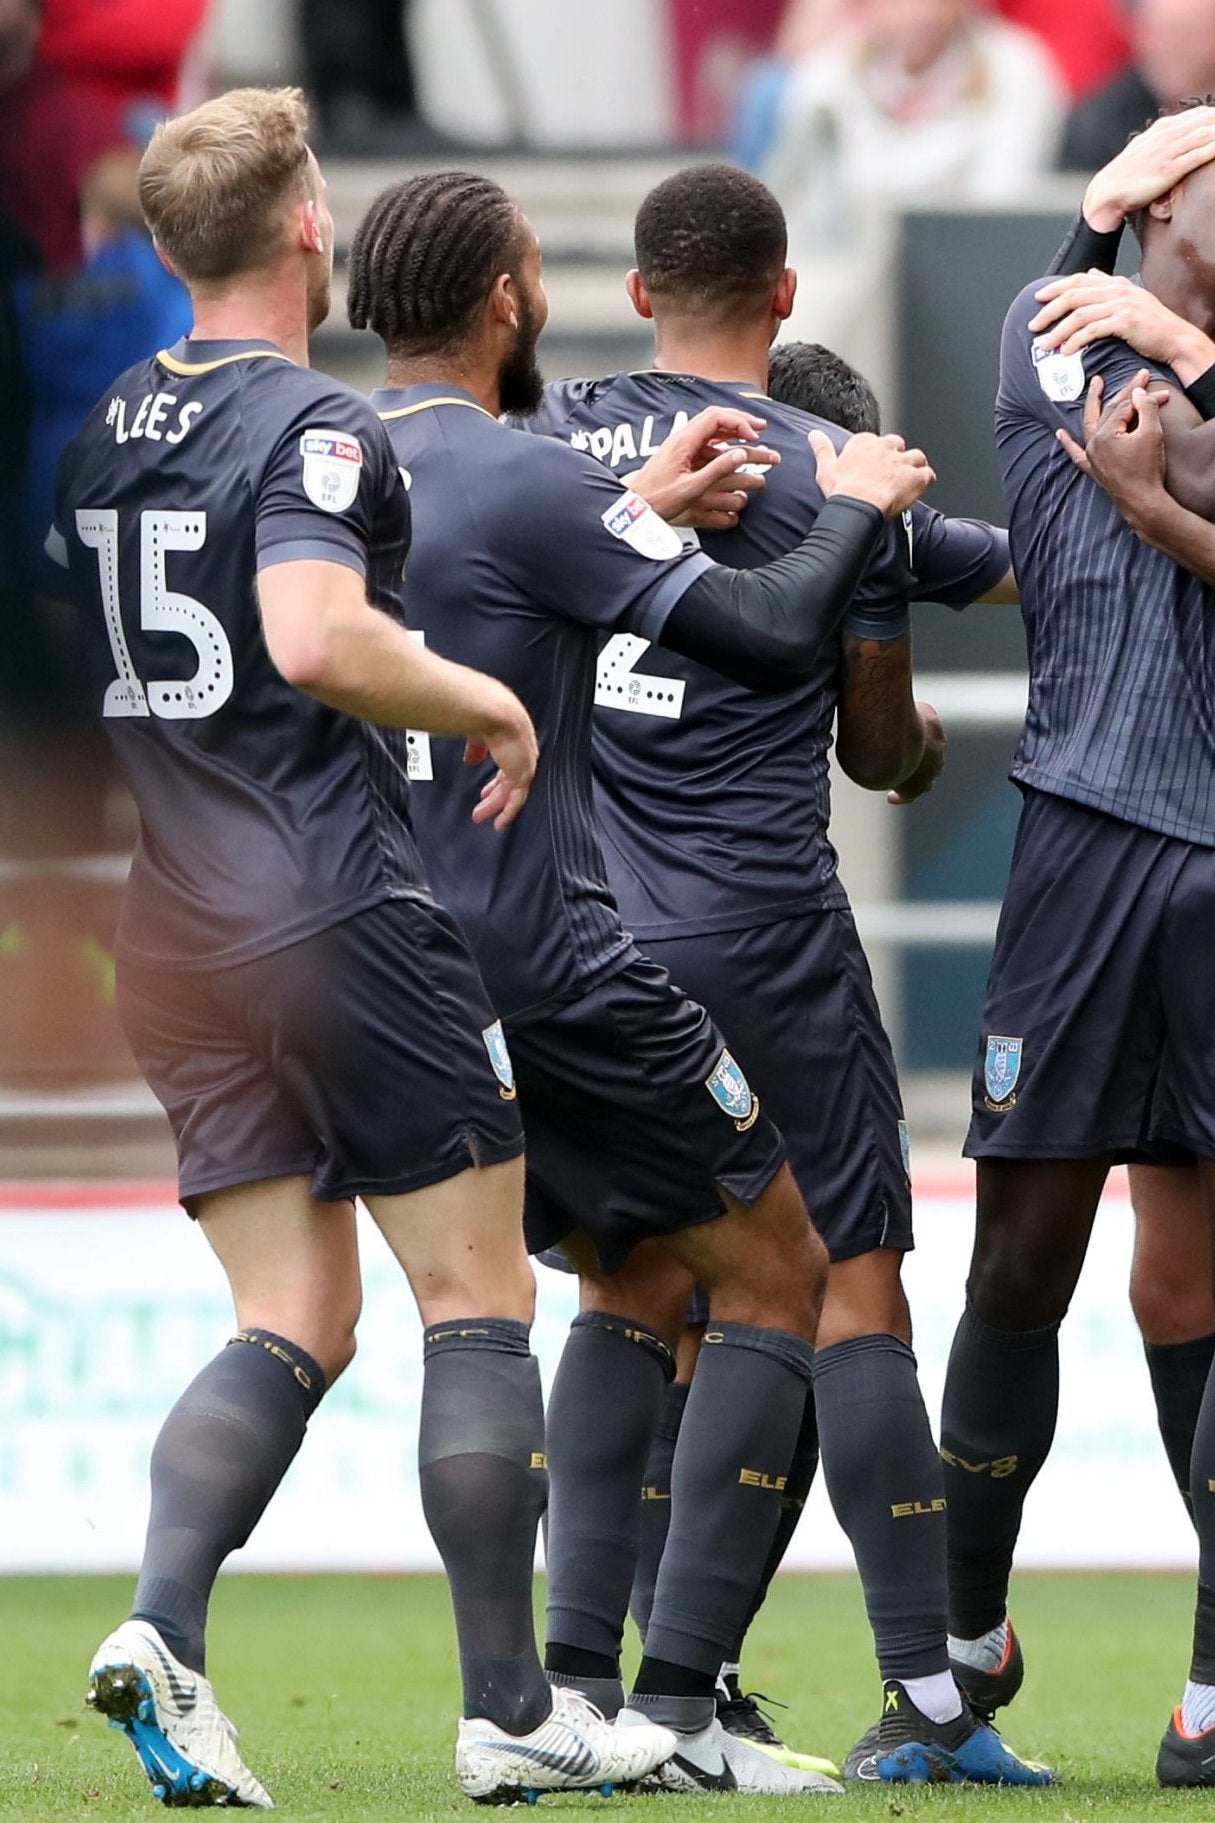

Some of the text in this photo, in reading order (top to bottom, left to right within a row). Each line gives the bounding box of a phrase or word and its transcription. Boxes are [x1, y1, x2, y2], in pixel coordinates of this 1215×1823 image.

[115, 392, 203, 444] LEES
[304, 438, 333, 456] sky
[75, 509, 234, 720] 15
